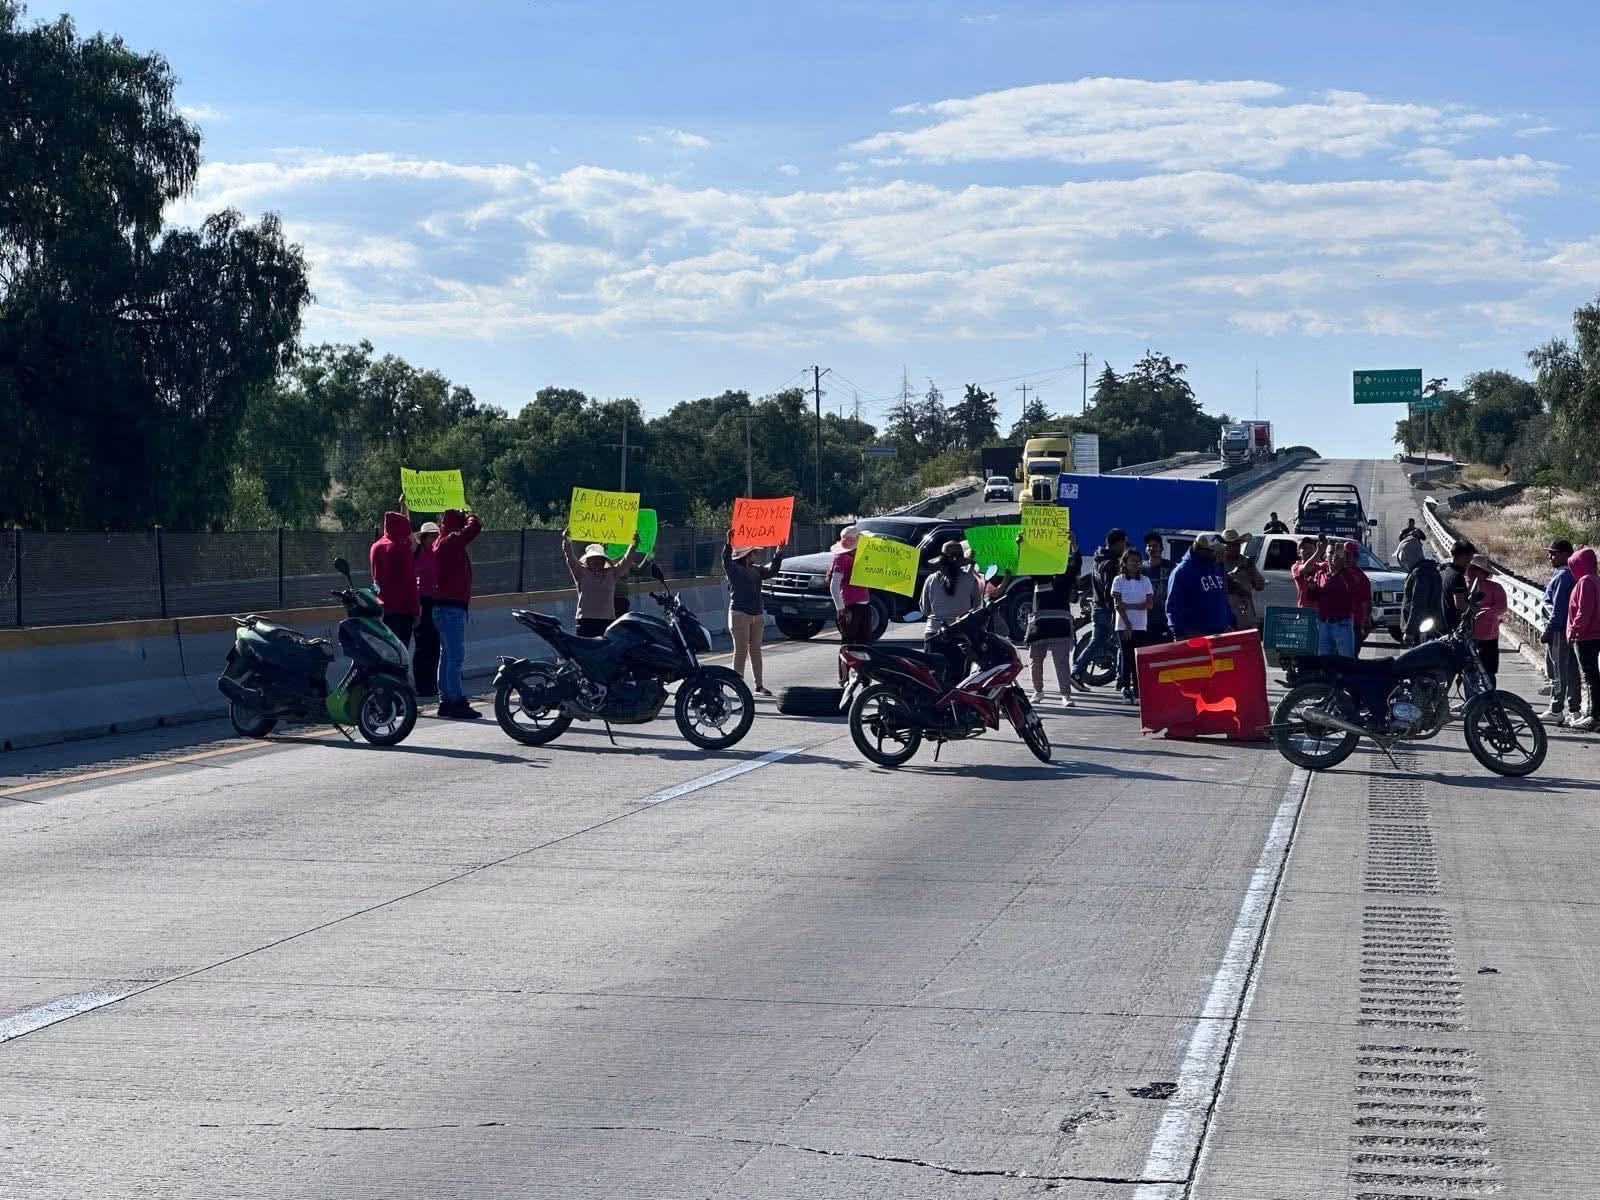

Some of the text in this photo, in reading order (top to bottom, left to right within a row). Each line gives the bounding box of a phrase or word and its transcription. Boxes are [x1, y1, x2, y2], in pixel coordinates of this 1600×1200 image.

[574, 489, 588, 504] LA
[573, 510, 625, 528] SANA Y
[578, 527, 618, 542] SALVA
[737, 523, 776, 539] AYUDA
